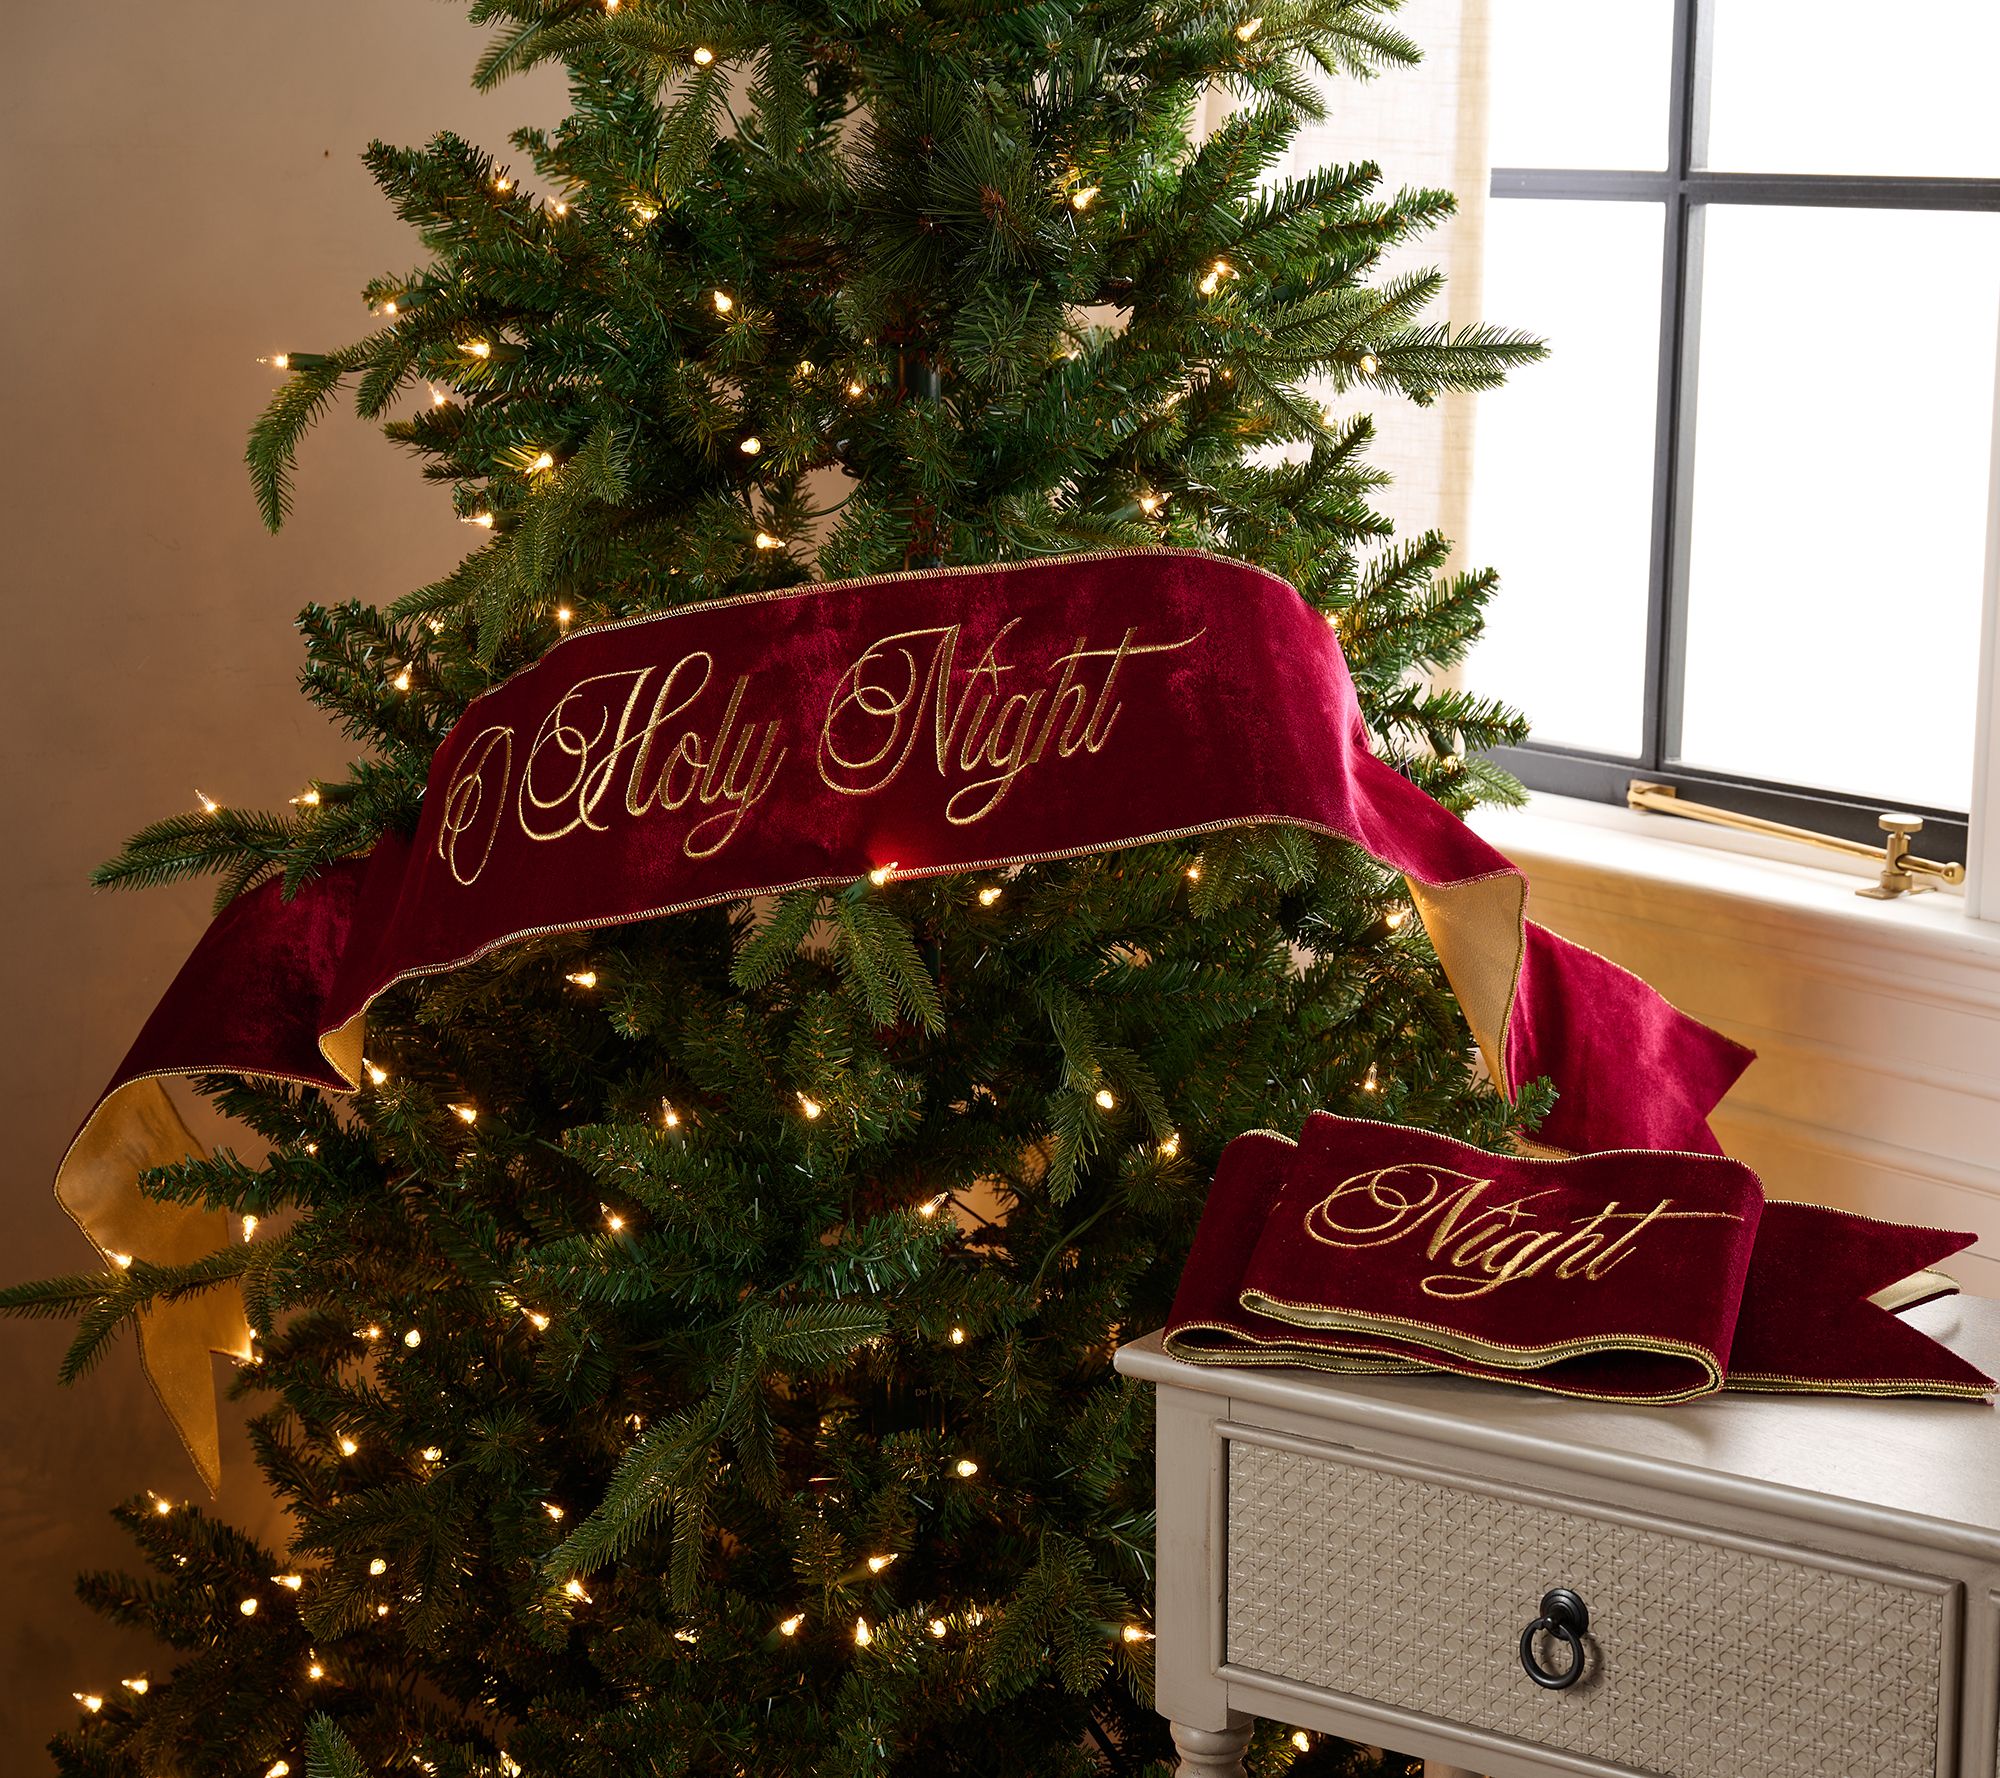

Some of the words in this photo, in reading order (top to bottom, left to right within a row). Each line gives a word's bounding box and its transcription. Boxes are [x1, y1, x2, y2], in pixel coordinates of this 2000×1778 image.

[438, 726, 514, 885] O
[518, 651, 788, 859] Holy
[818, 617, 1207, 826] Night
[1304, 1163, 1745, 1299] Night
